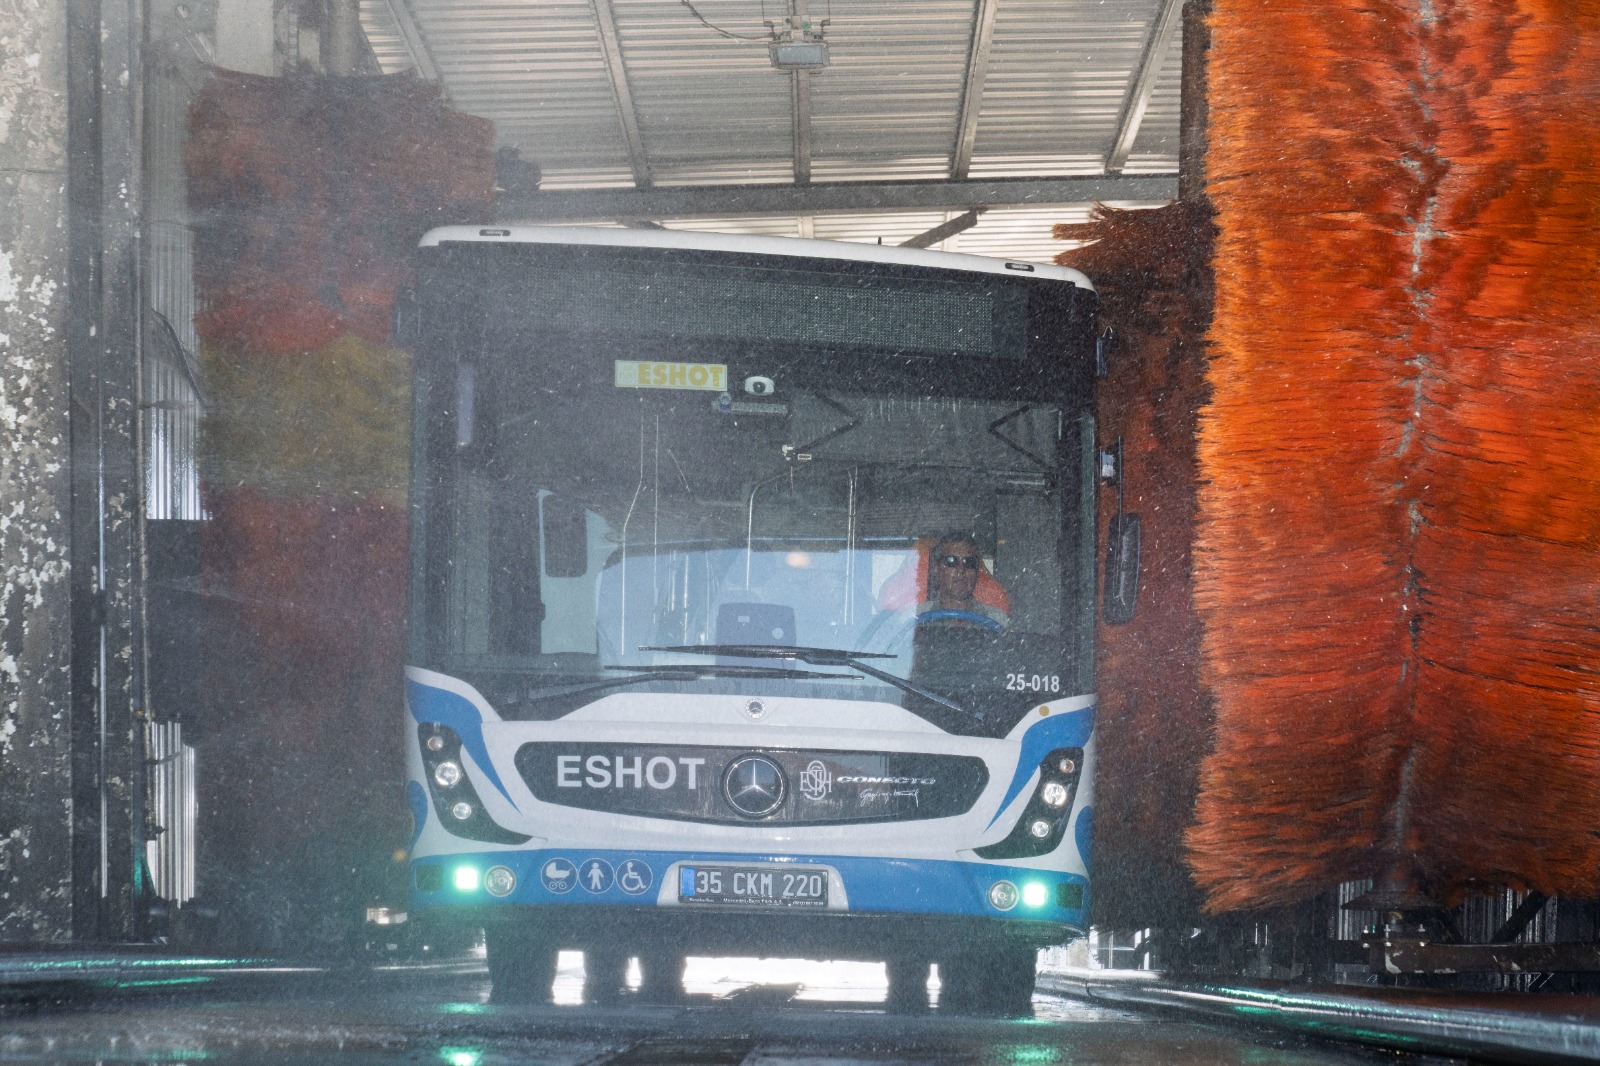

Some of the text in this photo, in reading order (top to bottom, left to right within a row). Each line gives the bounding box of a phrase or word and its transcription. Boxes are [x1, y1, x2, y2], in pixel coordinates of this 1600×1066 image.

[637, 363, 724, 387] ESHOT
[1006, 673, 1060, 693] 25-018
[557, 755, 706, 790] ESHOT
[696, 871, 822, 897] 35 CKM 220
